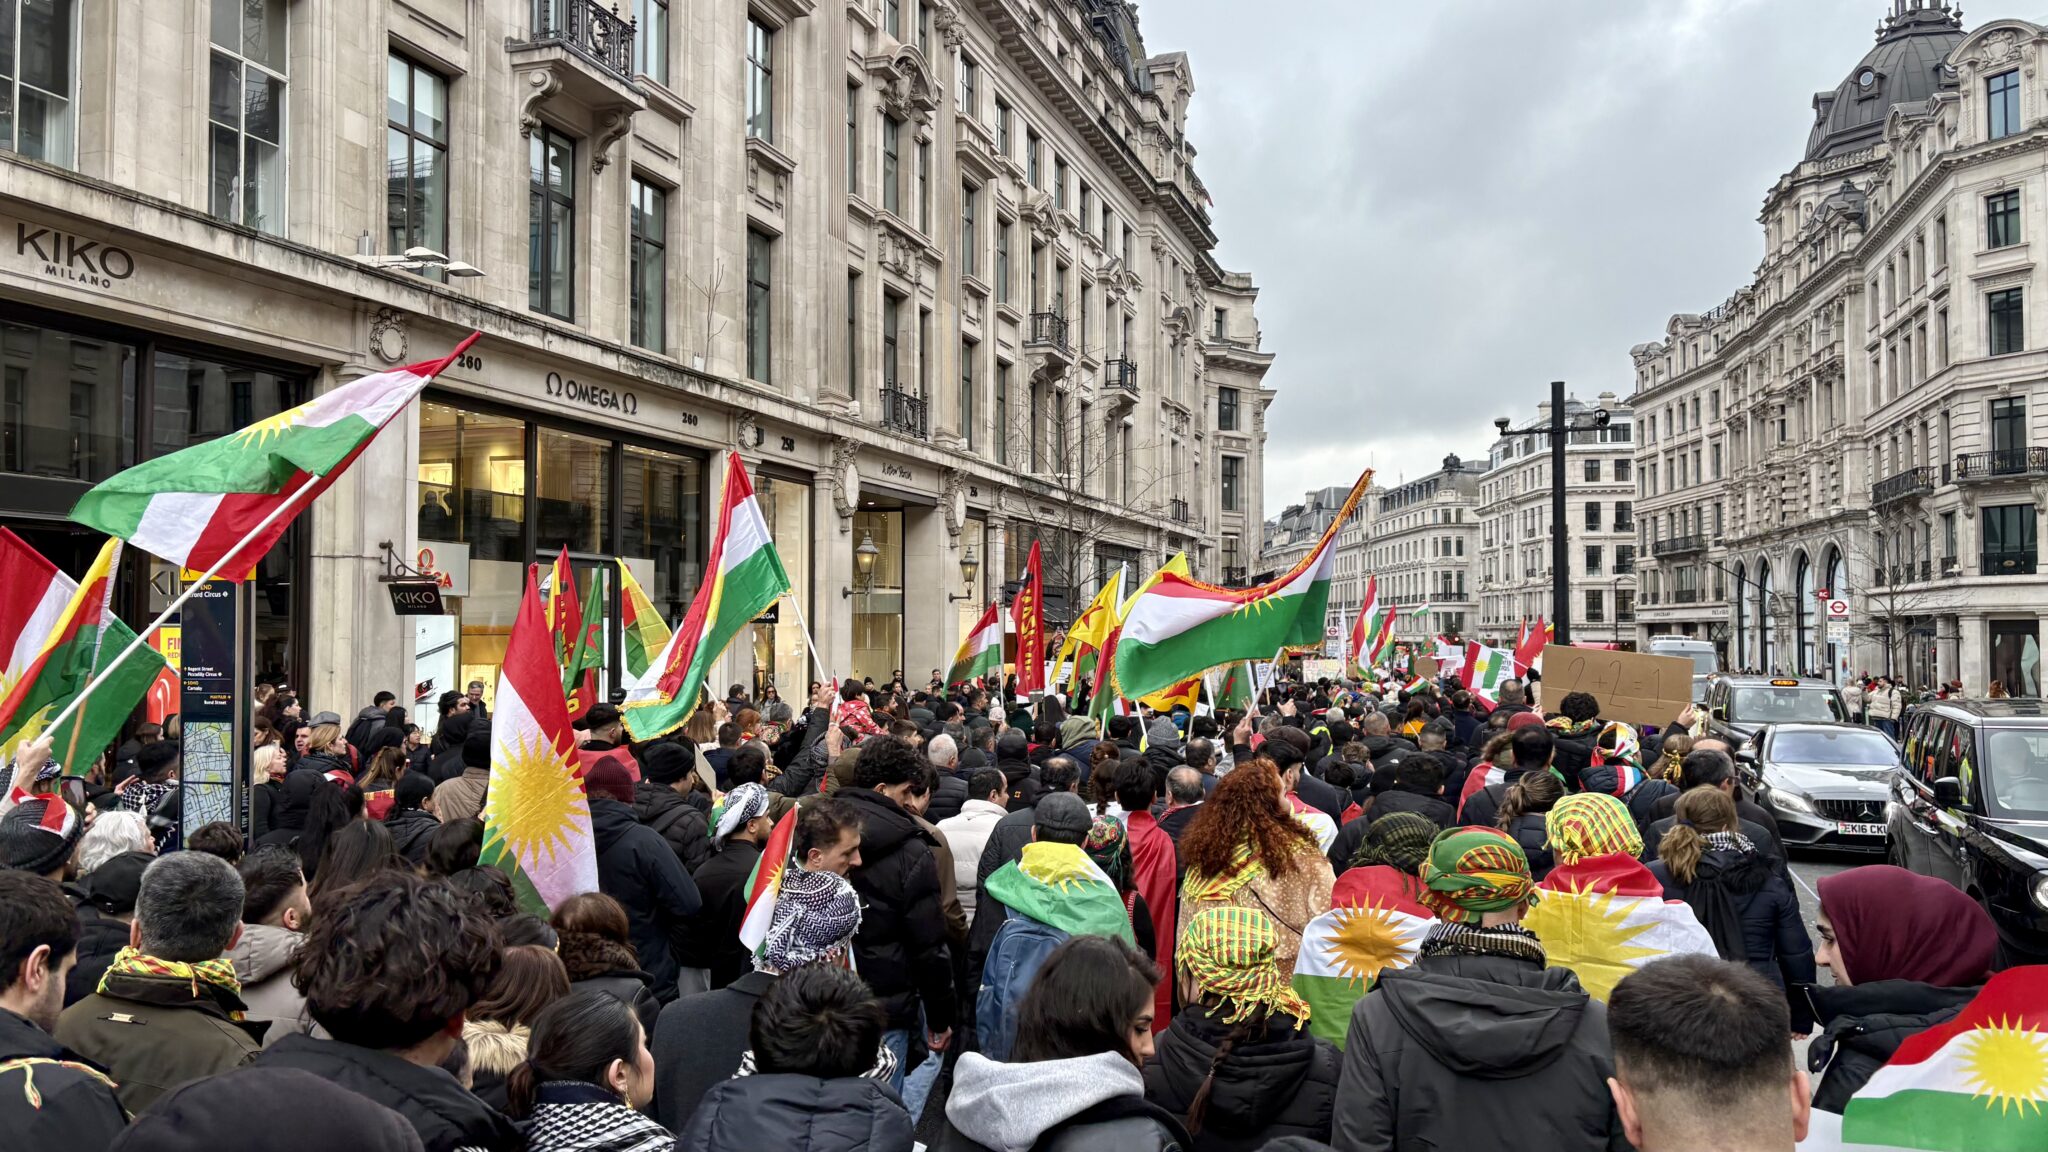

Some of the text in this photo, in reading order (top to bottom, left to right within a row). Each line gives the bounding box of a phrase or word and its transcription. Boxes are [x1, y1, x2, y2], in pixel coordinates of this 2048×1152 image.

[17, 223, 134, 280] KIKO
[45, 265, 111, 288] MILANO
[457, 353, 482, 371] 260
[566, 380, 620, 411] OMEGA
[682, 412, 698, 426] 260
[393, 591, 436, 604] KIKO
[167, 637, 180, 650] FI
[1844, 824, 1867, 834] EK16
